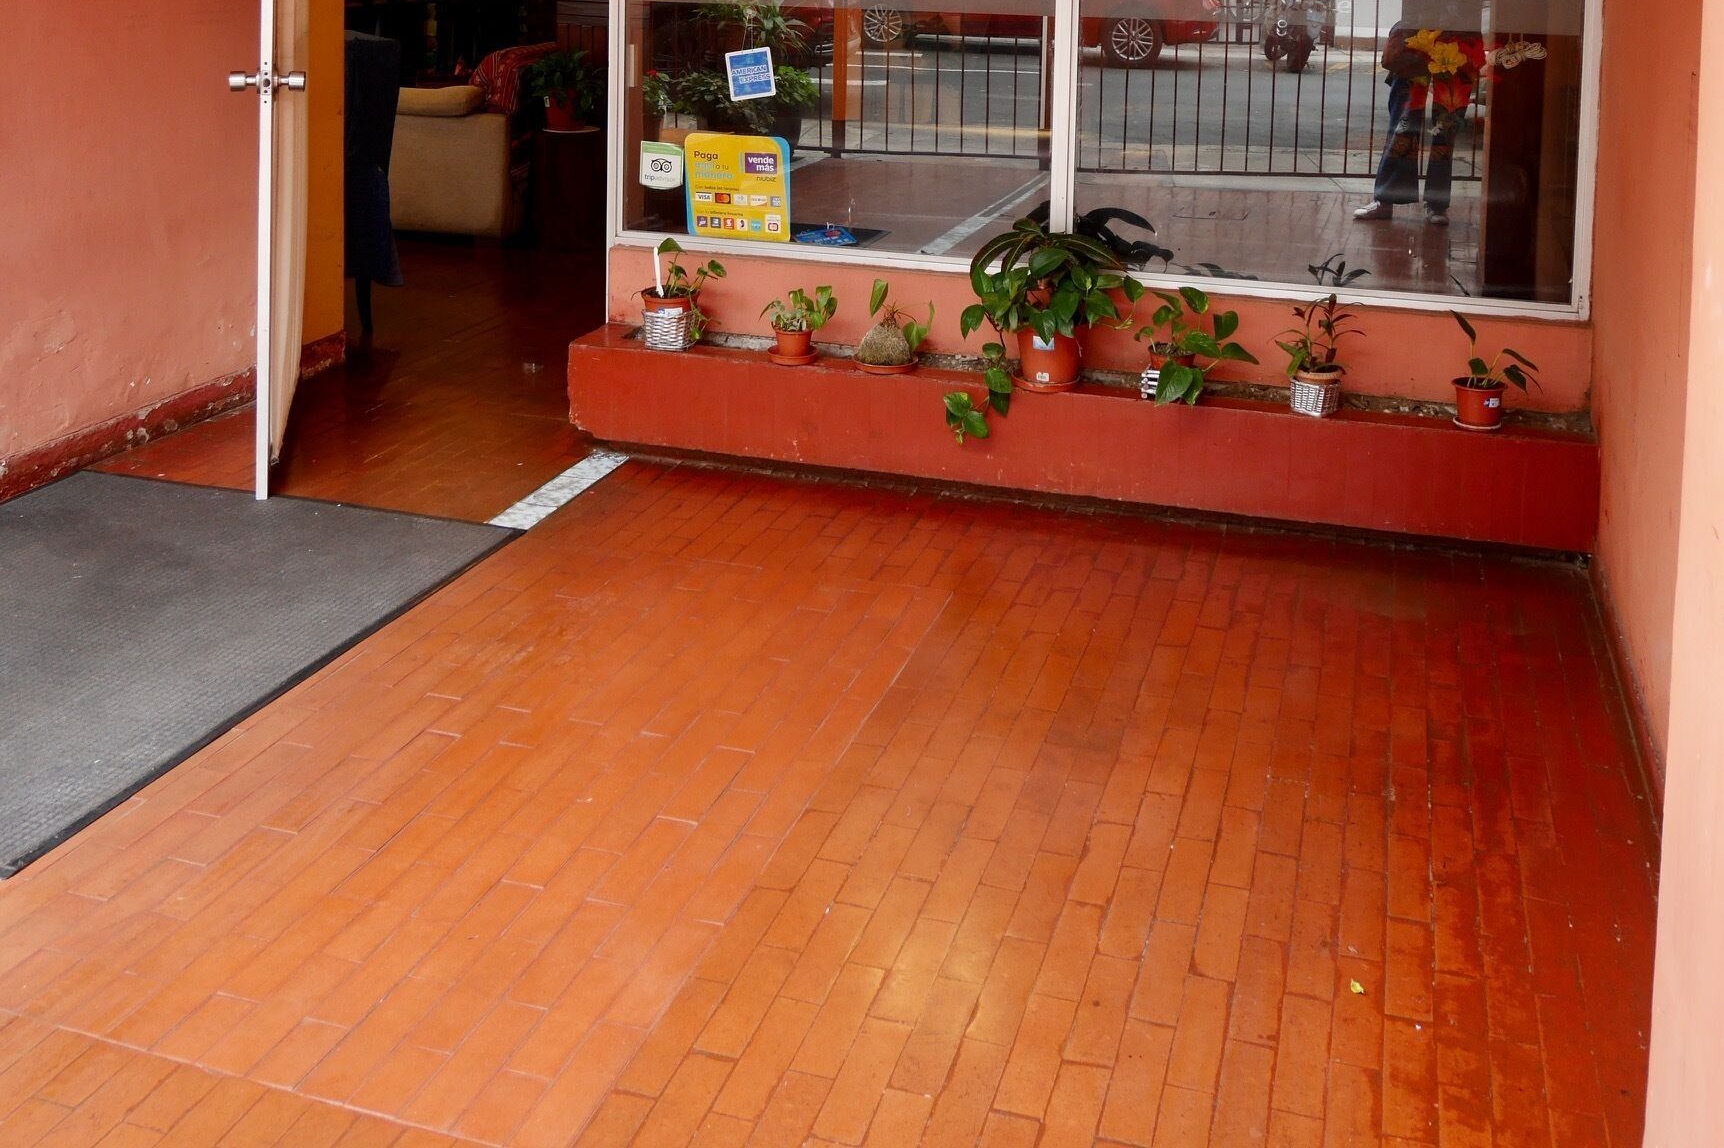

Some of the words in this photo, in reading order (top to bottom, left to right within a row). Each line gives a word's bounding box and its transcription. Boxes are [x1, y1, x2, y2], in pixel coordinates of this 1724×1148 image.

[731, 64, 768, 76] AMERICAN
[739, 73, 771, 84] EXPRESS
[693, 150, 719, 162] Paga
[747, 155, 775, 165] vende
[756, 163, 775, 172] más
